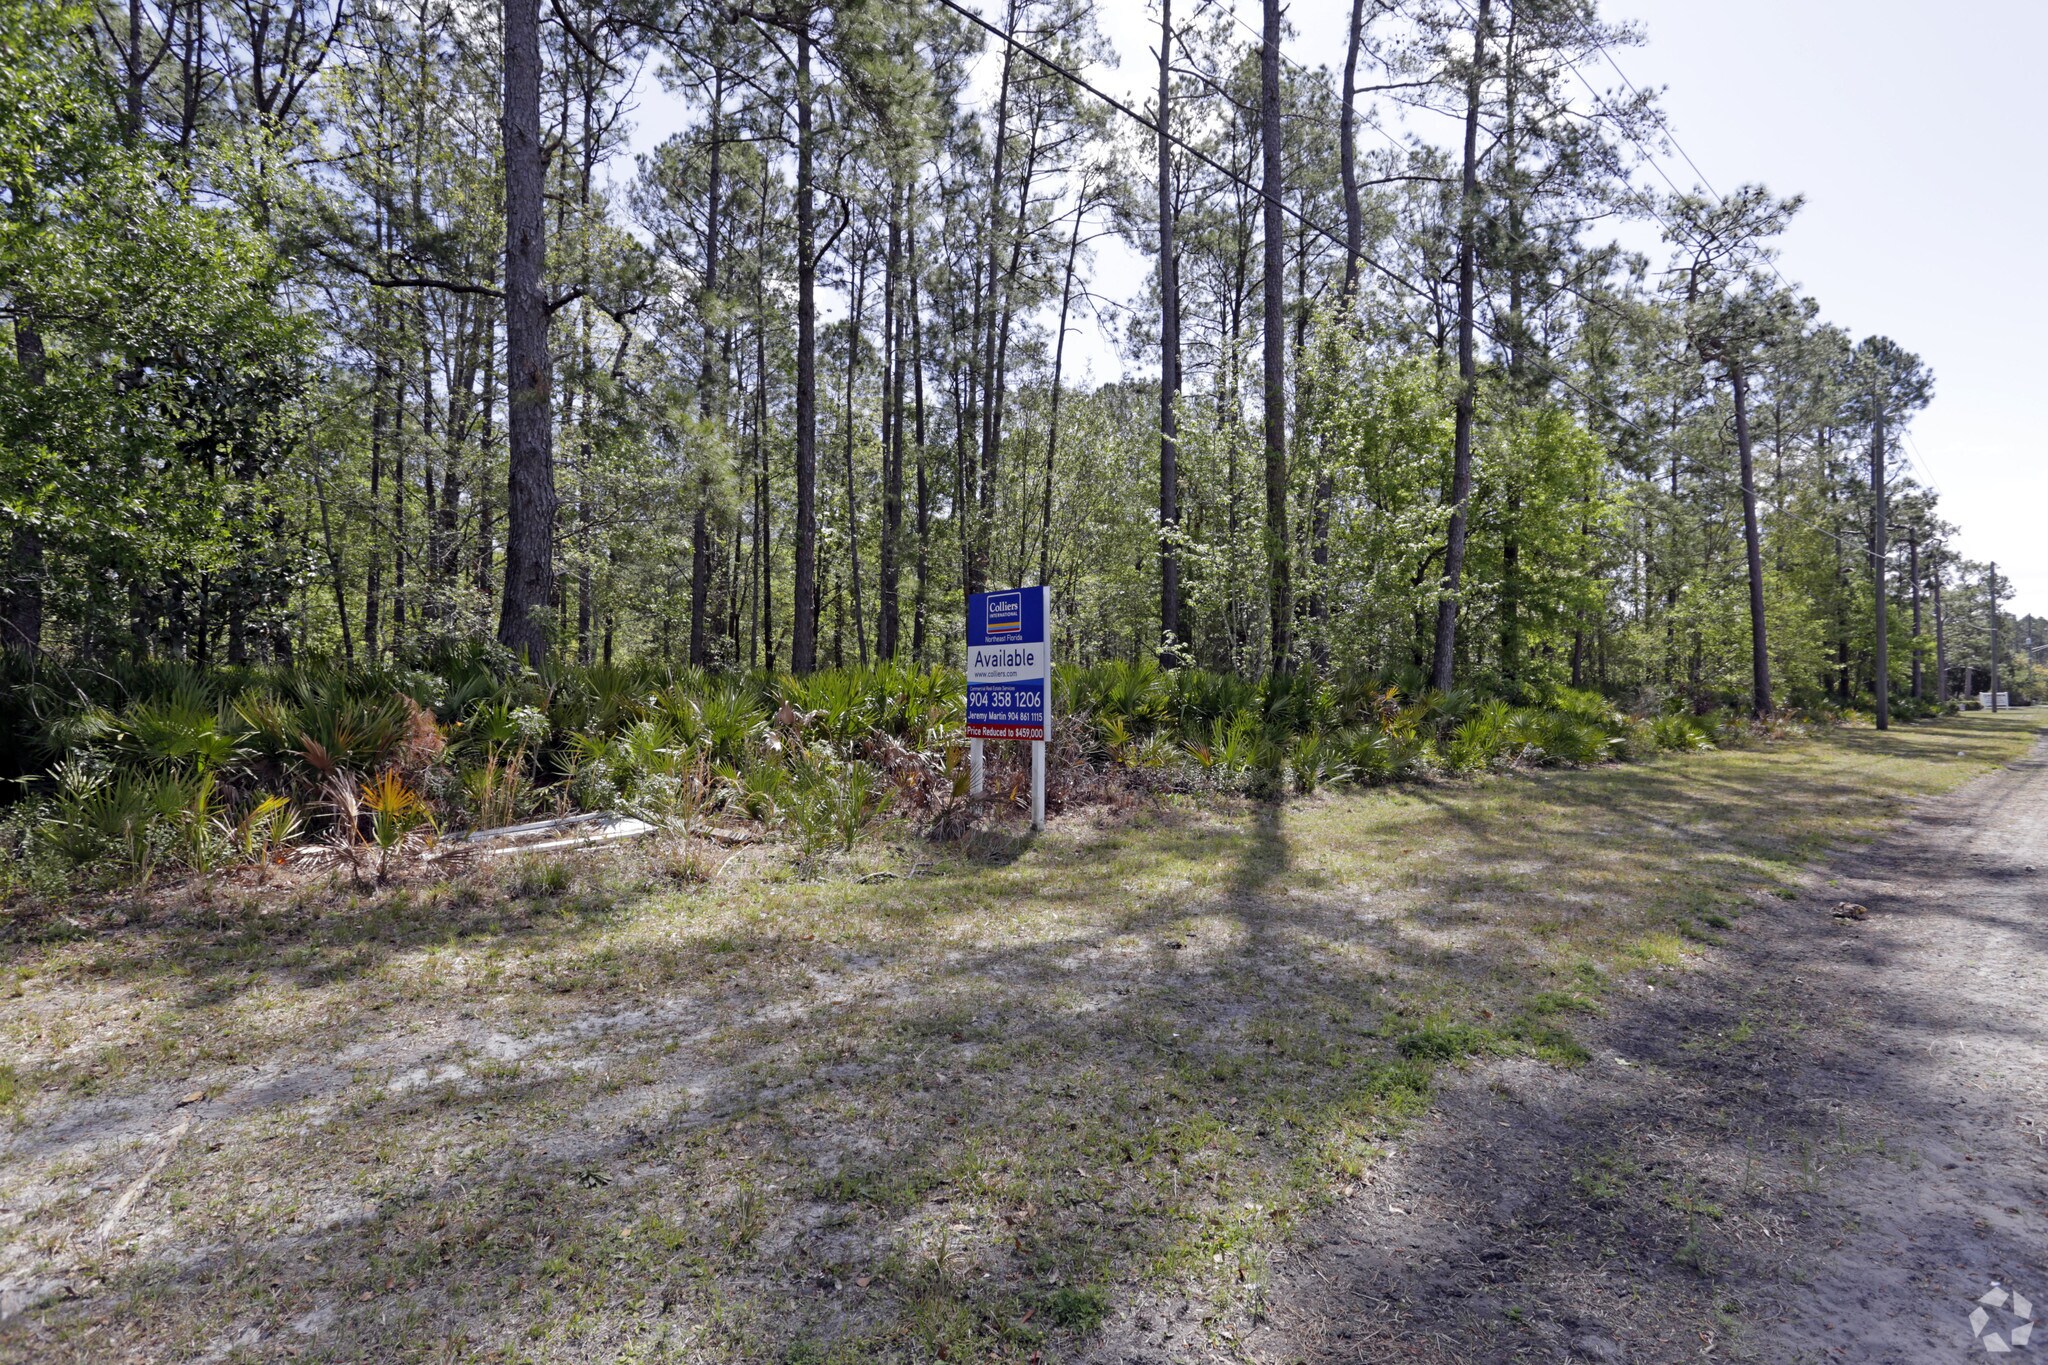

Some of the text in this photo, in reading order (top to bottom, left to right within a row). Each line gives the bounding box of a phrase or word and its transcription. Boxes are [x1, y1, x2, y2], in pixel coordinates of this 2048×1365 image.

[989, 602, 1018, 612] Colliers
[1006, 634, 1023, 642] Florida
[974, 649, 1034, 667] Available
[969, 692, 1041, 707] 904 358 1206
[968, 711, 988, 721] Jeremy
[988, 711, 1007, 720] Martin
[1007, 712, 1019, 721] 904
[1031, 713, 1043, 722] 1115
[967, 726, 982, 736] Price
[982, 727, 1007, 737] Reduced
[1008, 728, 1014, 737] to
